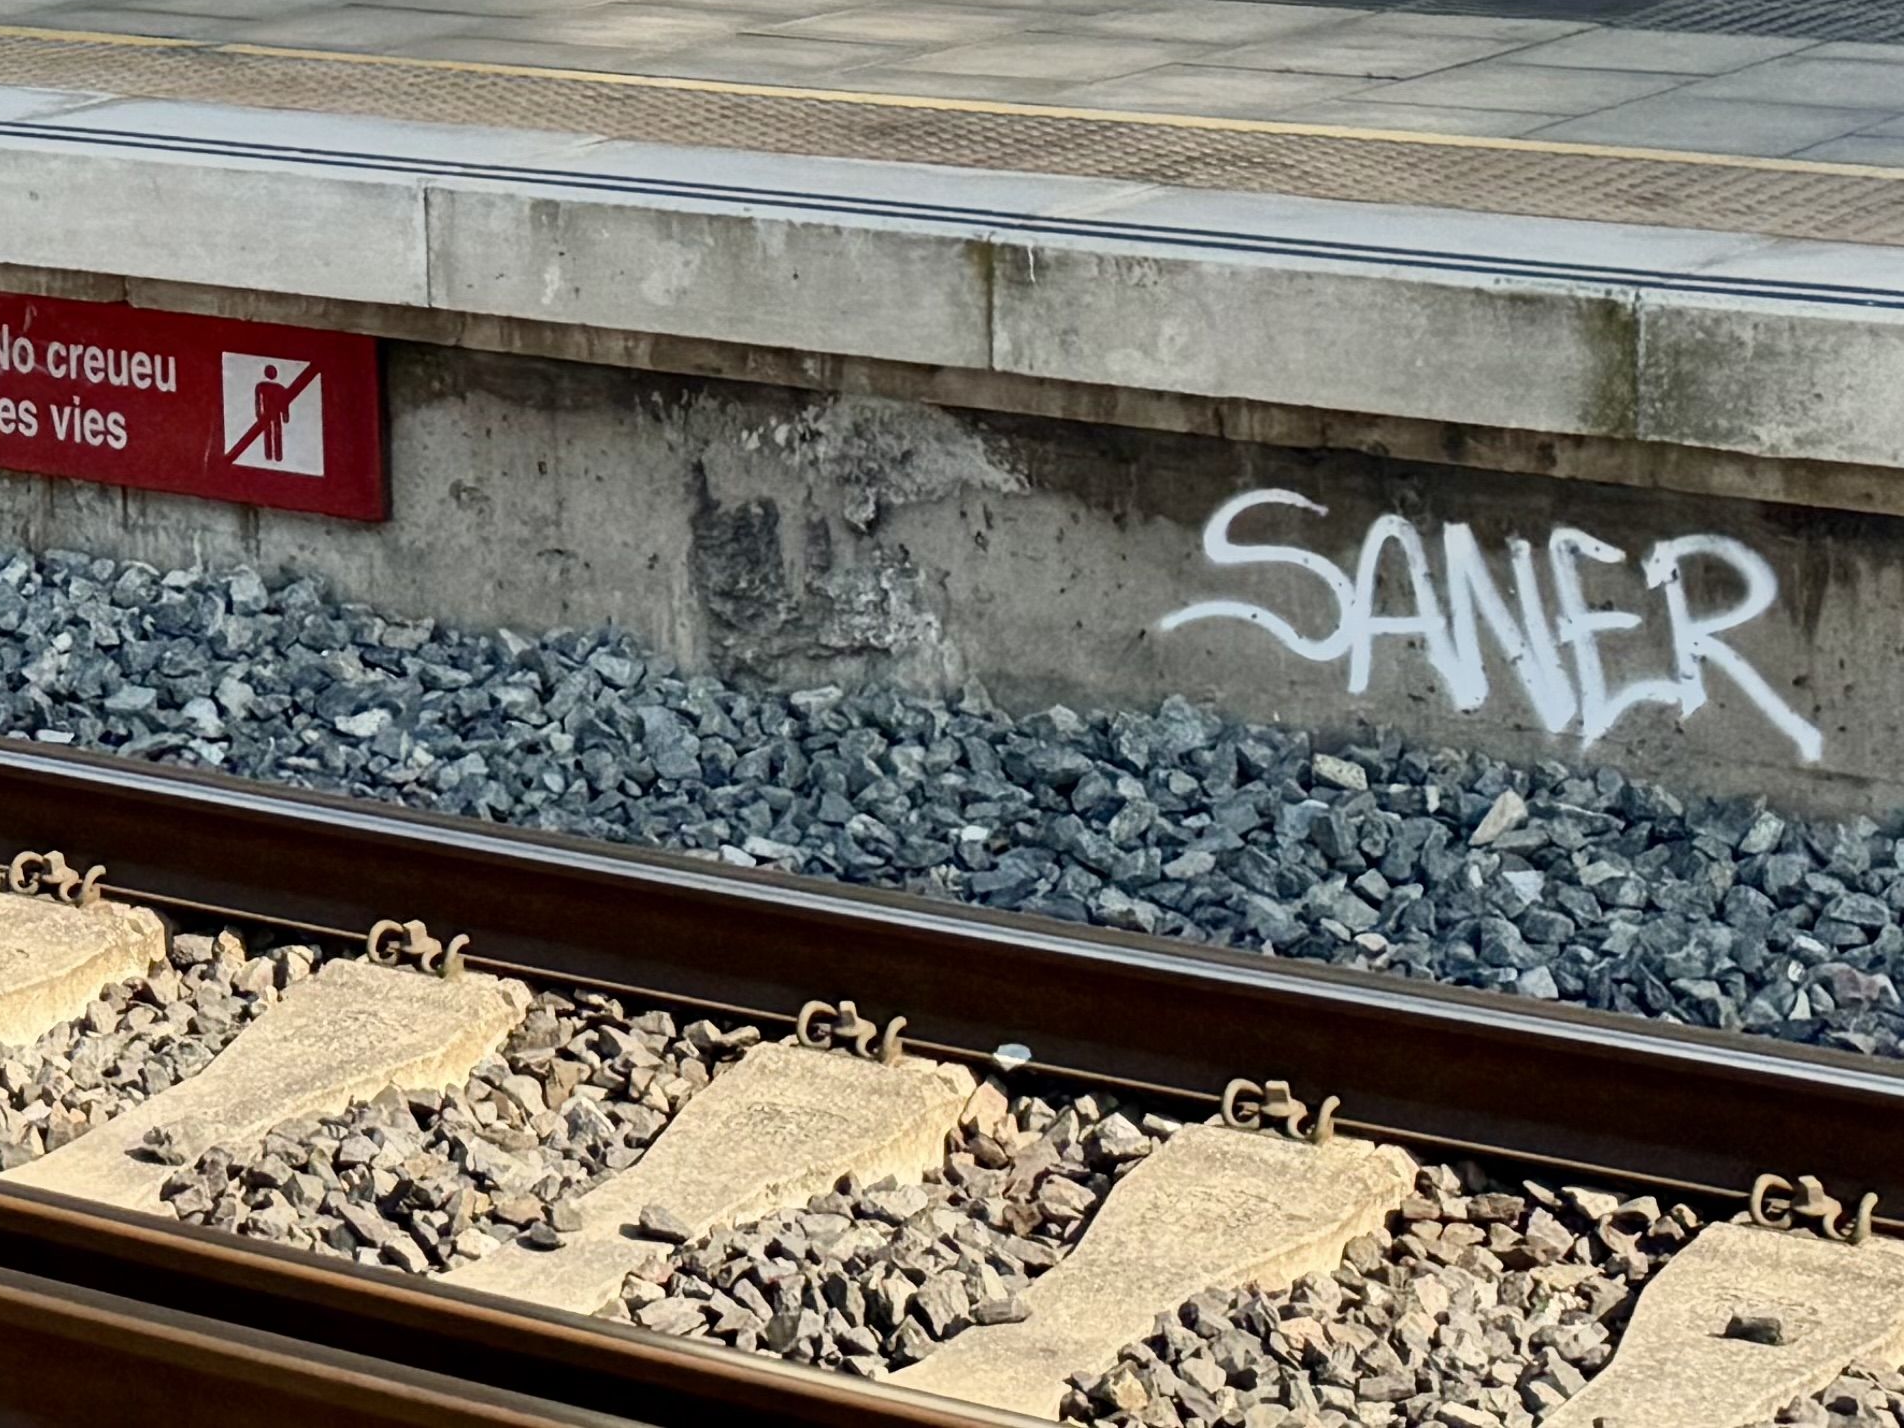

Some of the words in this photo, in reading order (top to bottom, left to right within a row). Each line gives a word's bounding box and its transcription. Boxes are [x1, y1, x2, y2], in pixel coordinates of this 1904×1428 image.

[46, 341, 177, 393] creueu
[50, 395, 128, 451] vies
[1158, 487, 1824, 763] SANER
